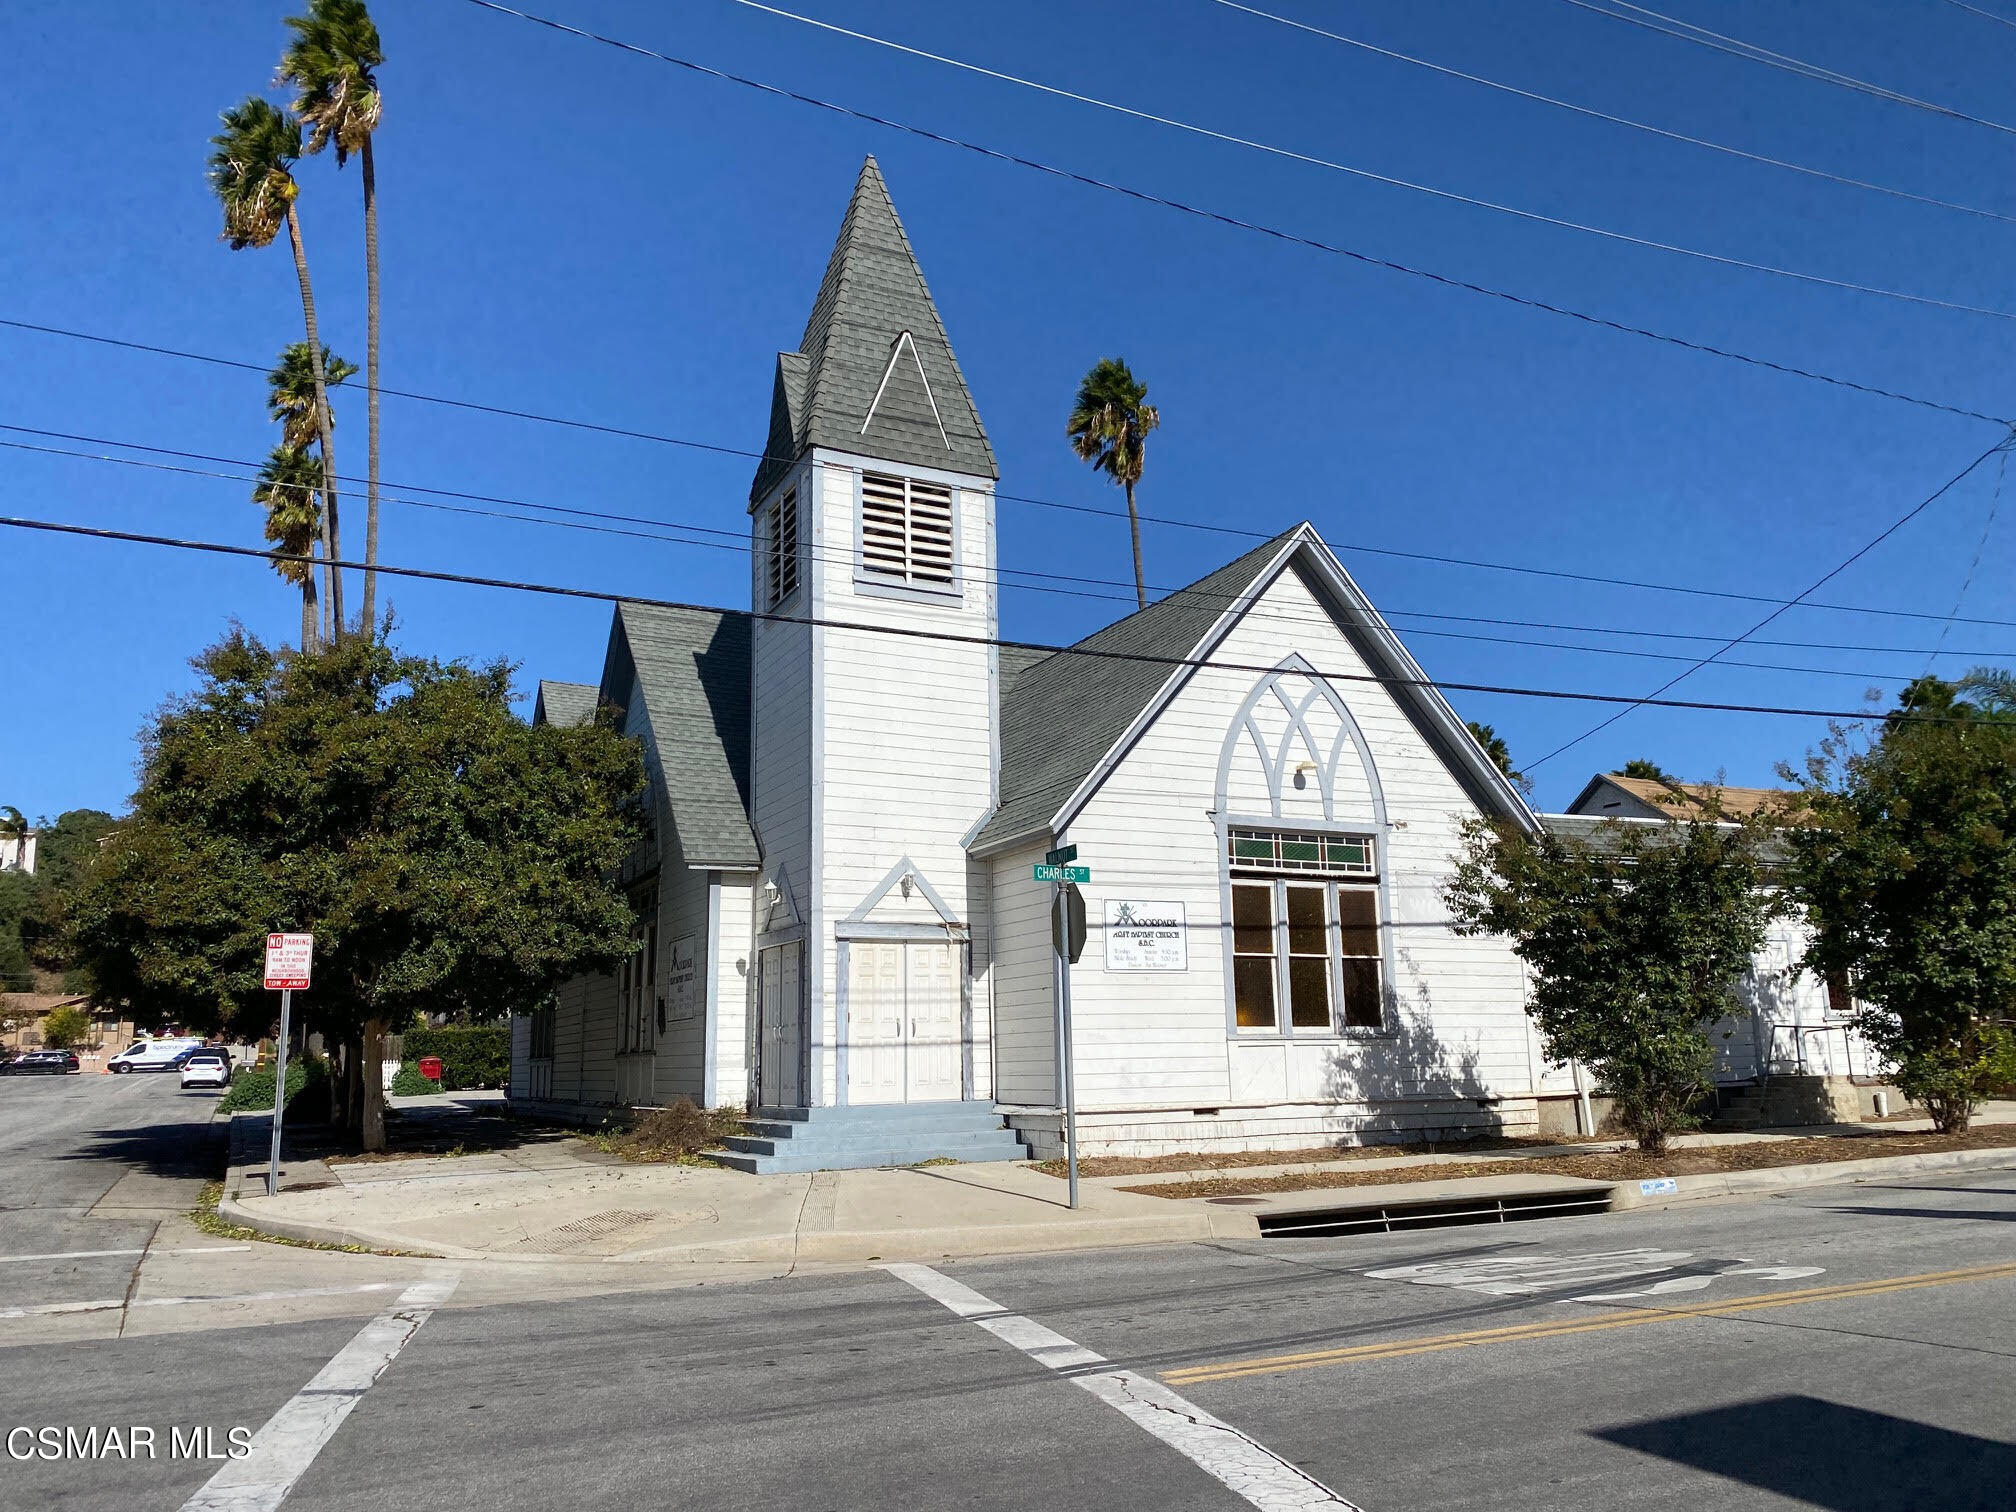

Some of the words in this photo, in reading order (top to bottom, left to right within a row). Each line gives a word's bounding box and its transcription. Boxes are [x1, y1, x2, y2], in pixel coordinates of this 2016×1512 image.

[1037, 866, 1076, 880] CHARLES
[1114, 915, 1178, 928] MOORPARK
[270, 936, 282, 948] NO
